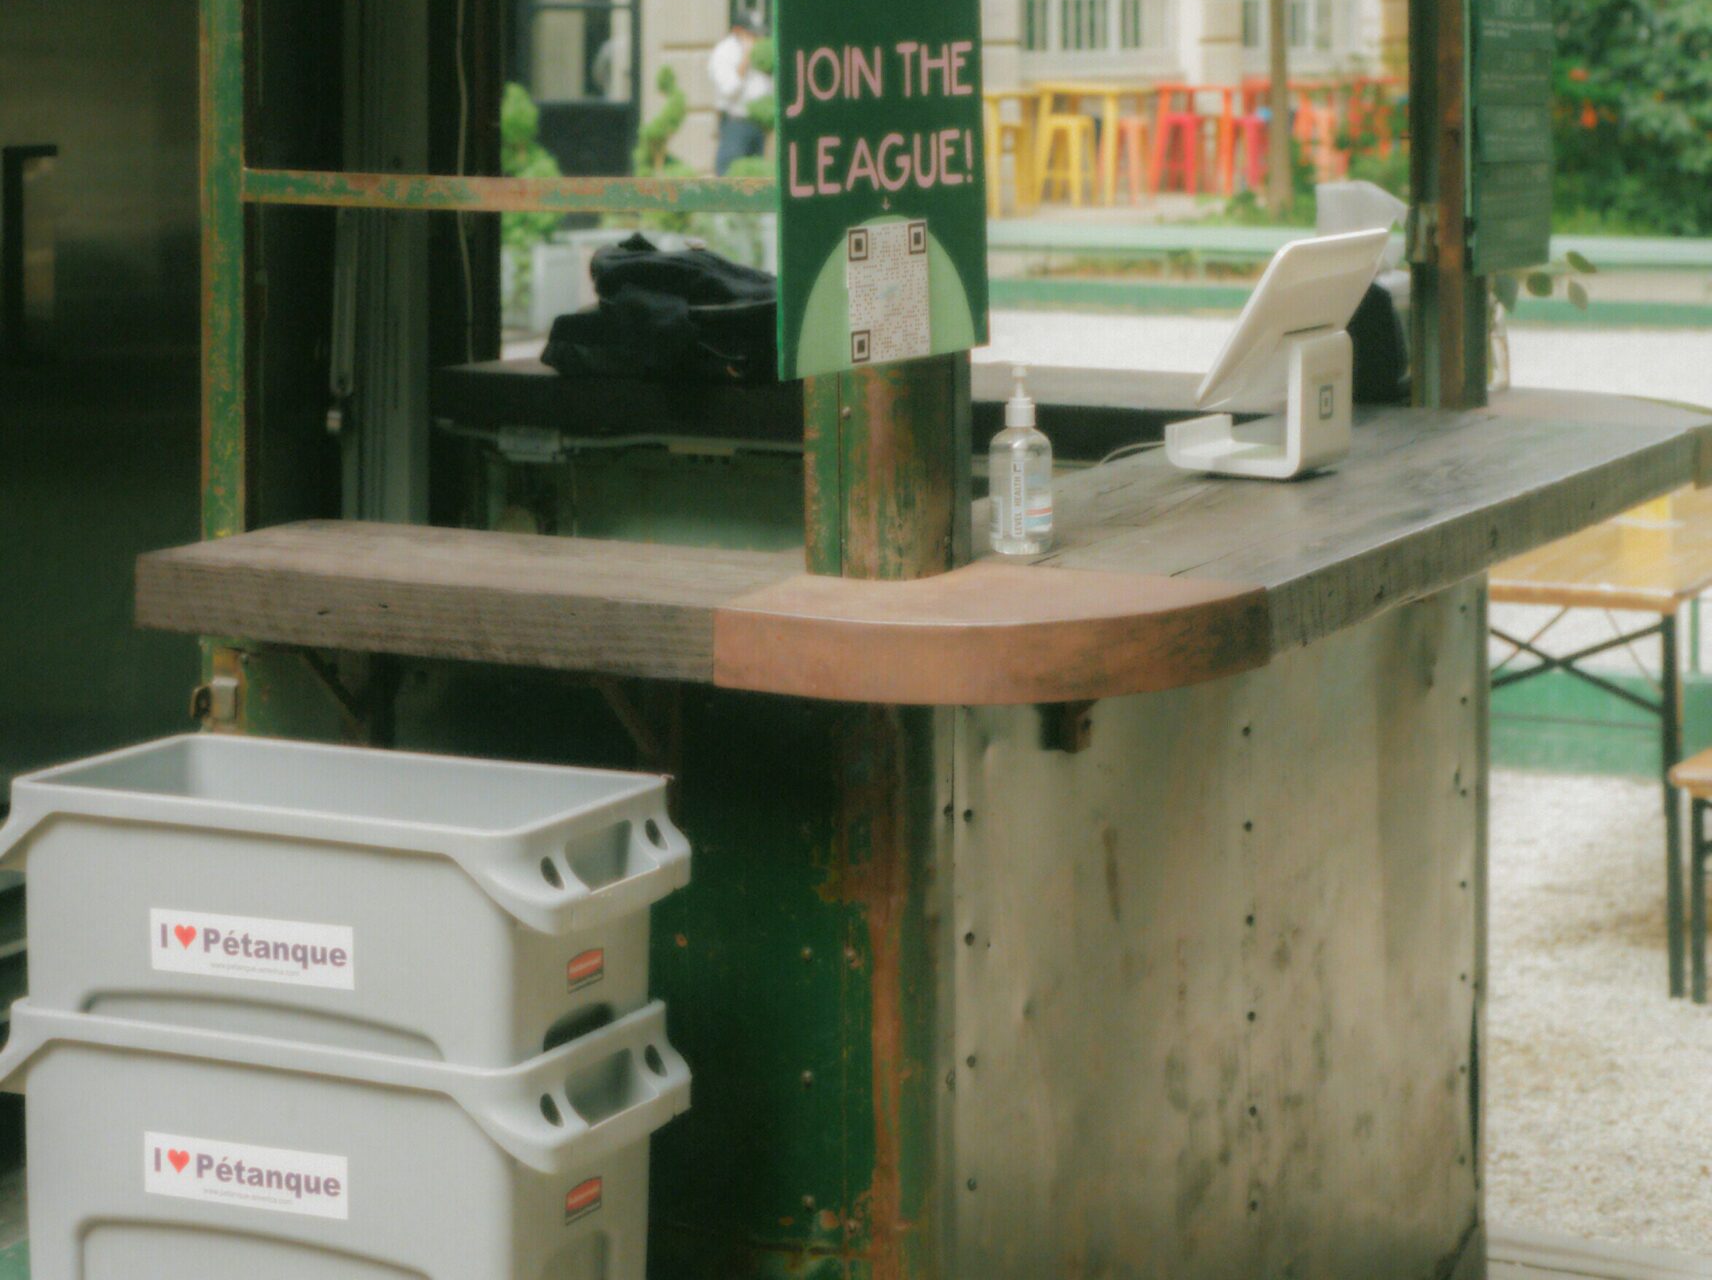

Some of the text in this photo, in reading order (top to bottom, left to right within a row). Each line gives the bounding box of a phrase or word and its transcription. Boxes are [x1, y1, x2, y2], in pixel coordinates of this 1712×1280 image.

[786, 41, 973, 118] JOIN THE
[788, 129, 974, 198] LEAGUE!
[160, 923, 347, 969] I Pétanque
[153, 1147, 341, 1199] I Pétanque
